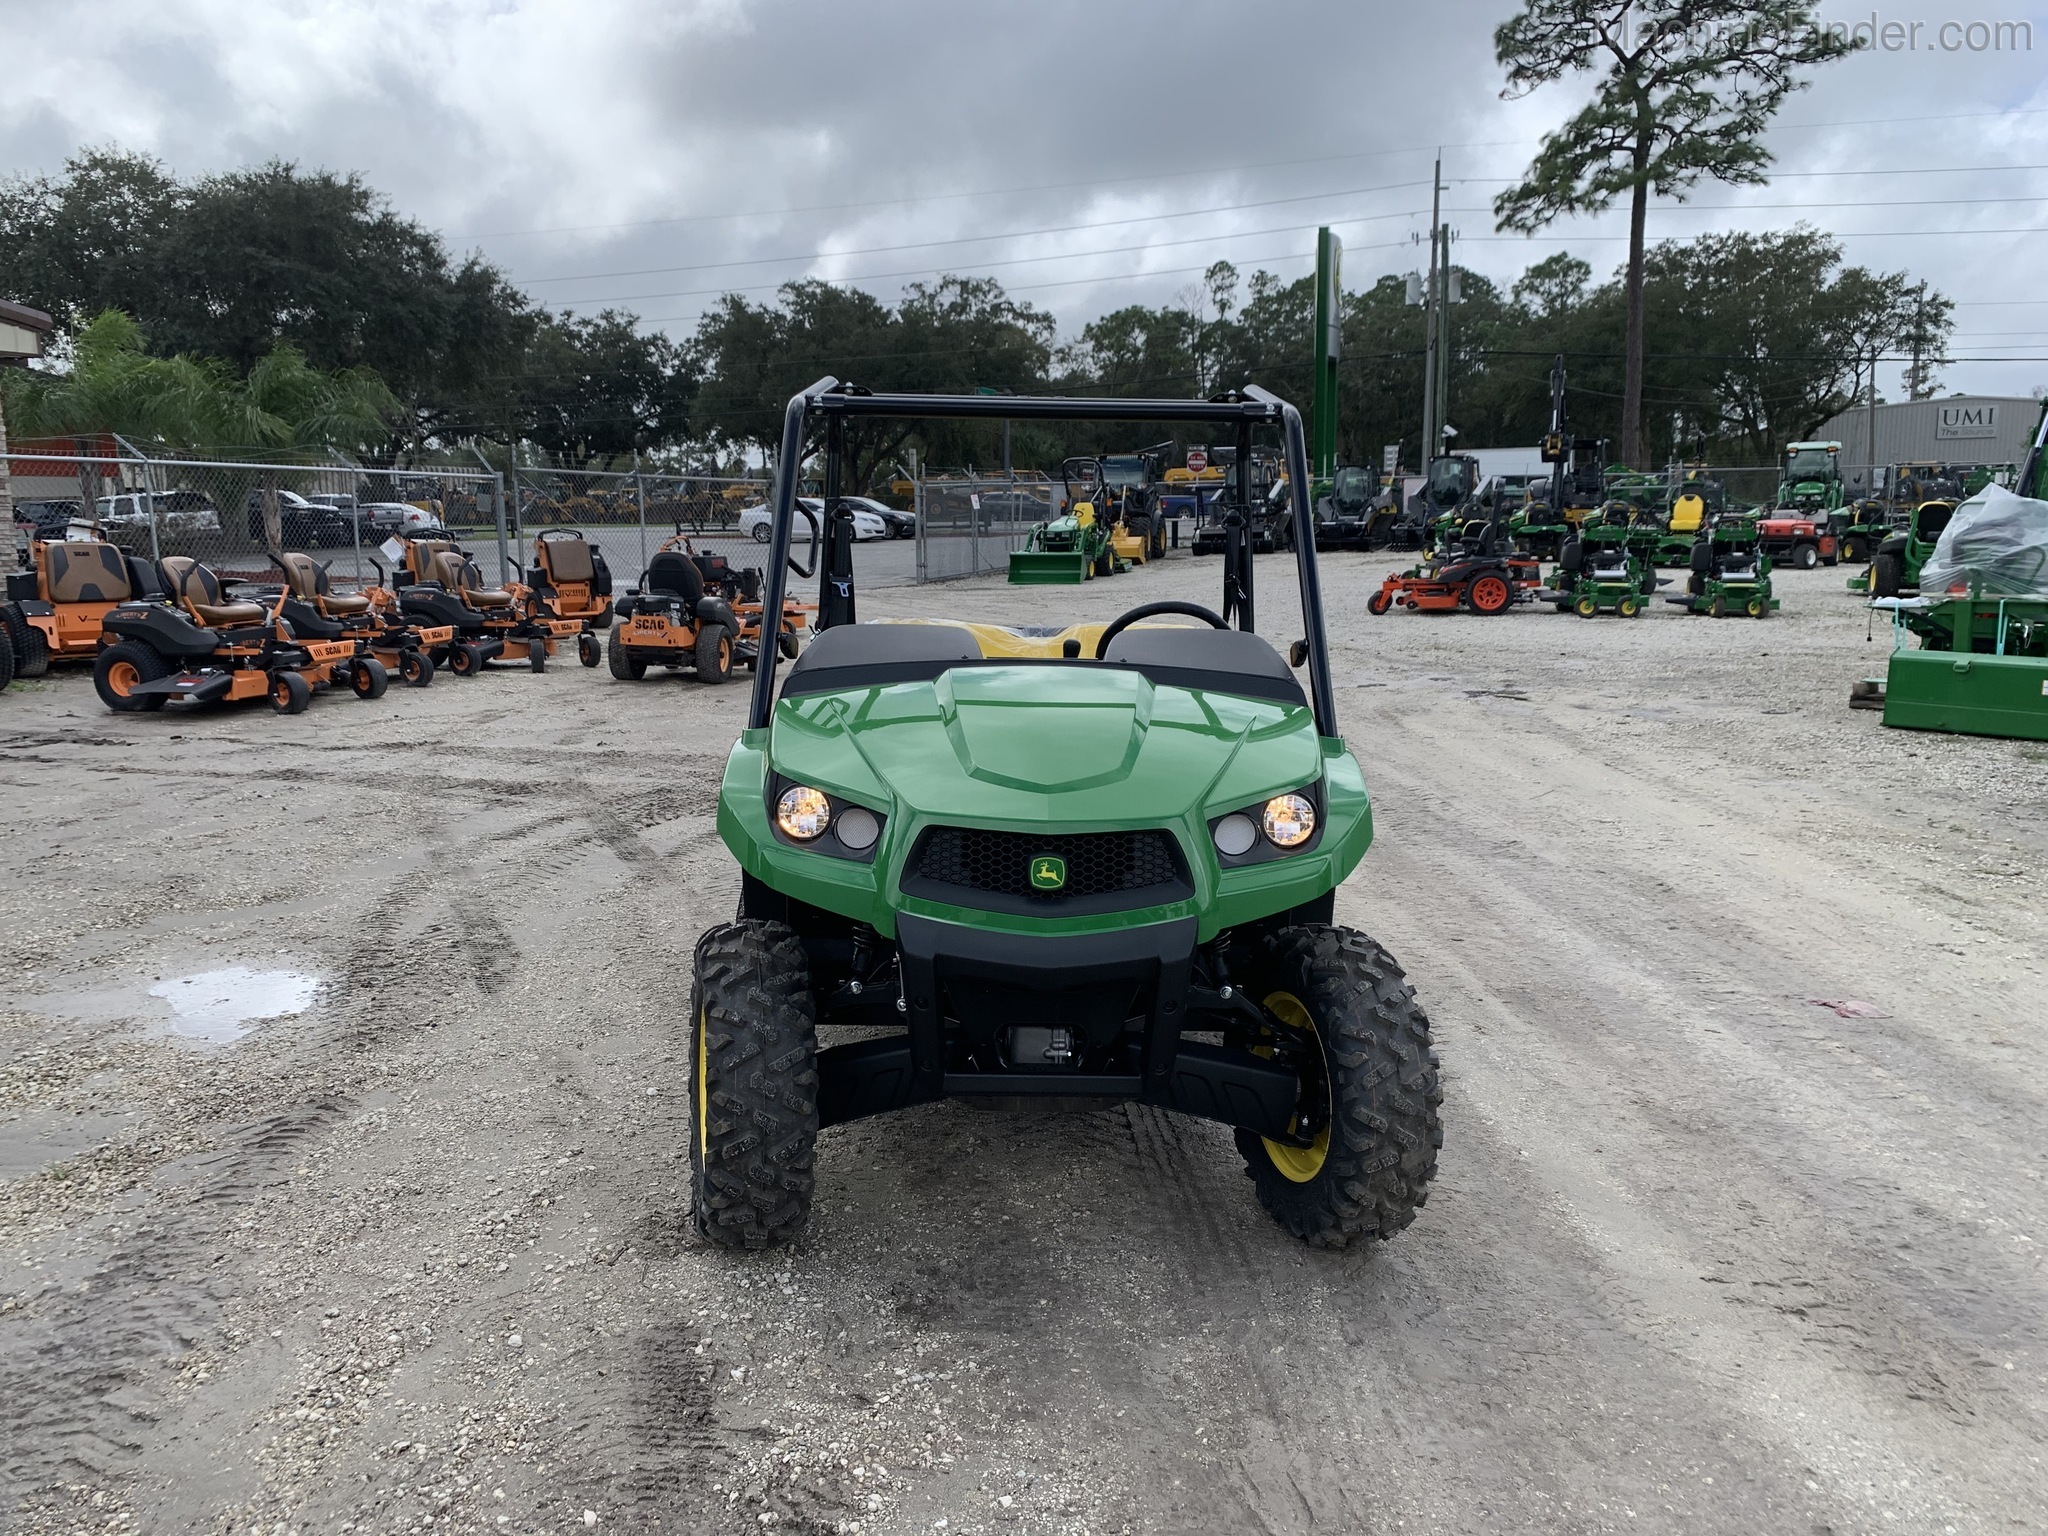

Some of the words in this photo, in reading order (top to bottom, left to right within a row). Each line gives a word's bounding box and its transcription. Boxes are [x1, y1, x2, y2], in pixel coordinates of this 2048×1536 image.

[1943, 407, 1995, 426] UMI
[1941, 428, 1959, 437] The
[1961, 428, 1994, 436] Source
[635, 619, 665, 630] SCAG
[325, 646, 341, 656] SCAG
